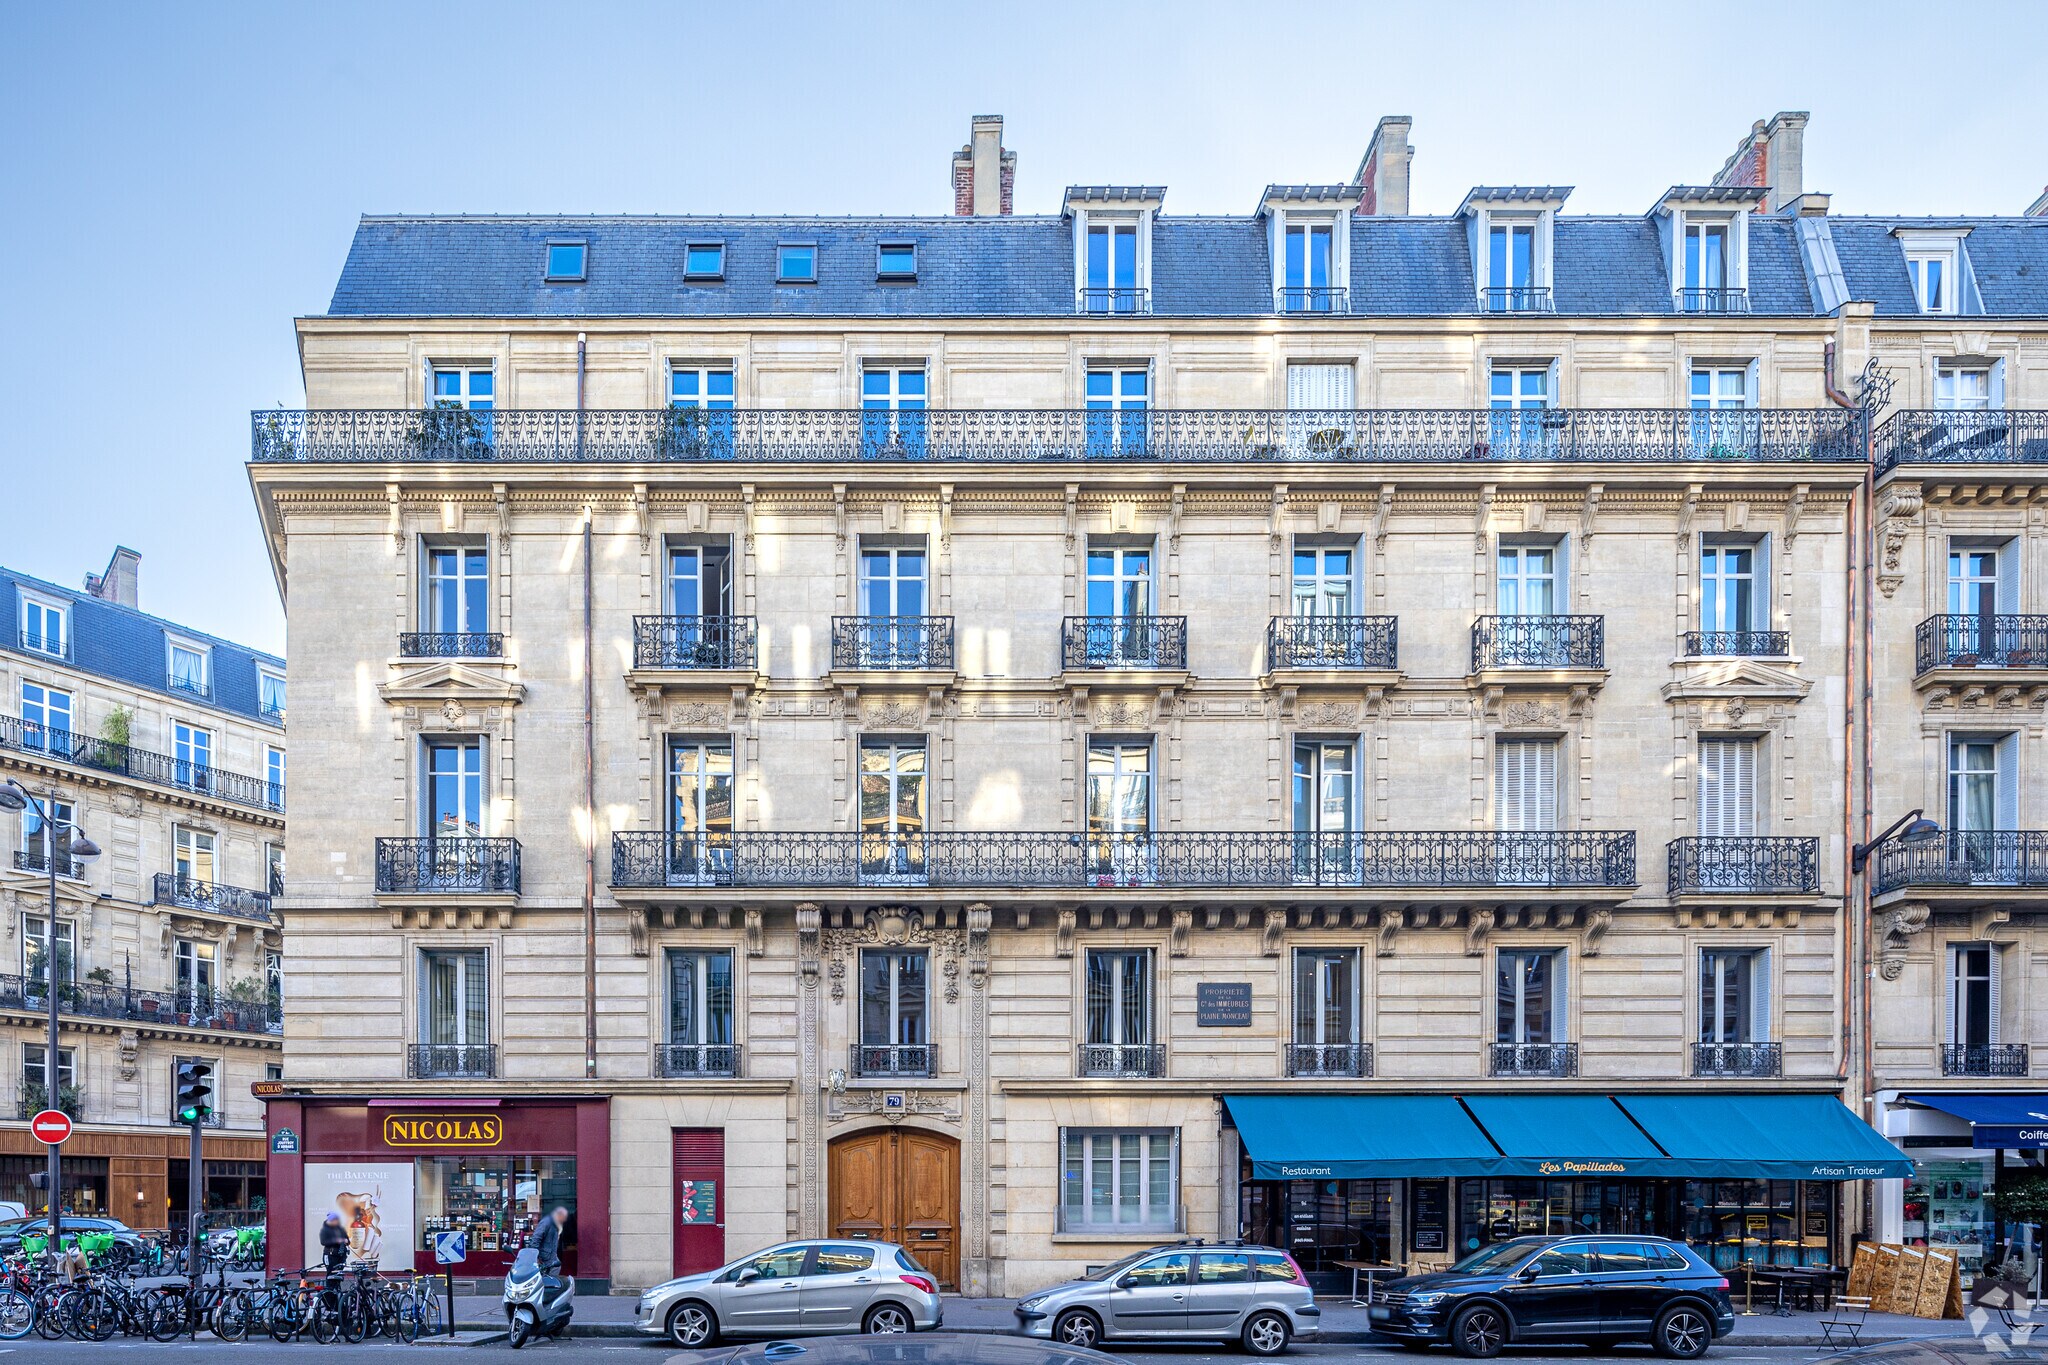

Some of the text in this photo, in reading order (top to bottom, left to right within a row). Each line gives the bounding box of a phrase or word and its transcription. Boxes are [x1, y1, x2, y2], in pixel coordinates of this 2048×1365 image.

[256, 1085, 281, 1093] NICOLAS
[889, 1097, 900, 1106] 79
[391, 1121, 496, 1140] NICOLAS
[2019, 1130, 2048, 1140] Coiffe
[1282, 1166, 1331, 1176] Restaurant
[1539, 1161, 1626, 1175] Les Papillades
[1812, 1166, 1885, 1176] Artisan Traiteur
